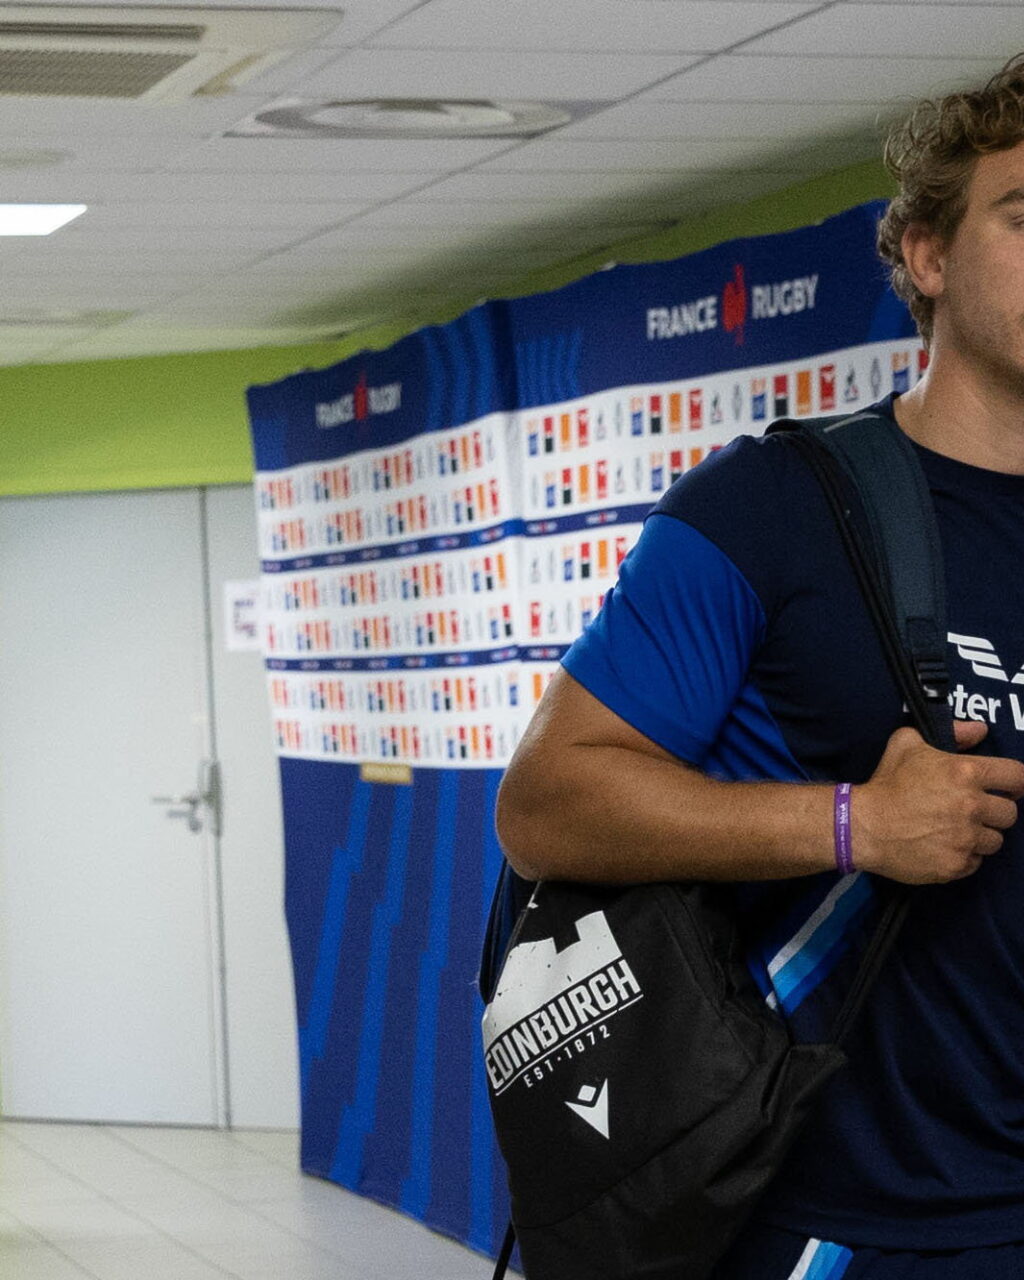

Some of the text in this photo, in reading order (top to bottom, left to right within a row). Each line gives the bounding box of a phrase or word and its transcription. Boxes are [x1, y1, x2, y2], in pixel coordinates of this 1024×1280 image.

[647, 274, 818, 341] FRANCE RUGBY
[924, 684, 1001, 724] ter
[485, 959, 641, 1090] EDINBURGH
